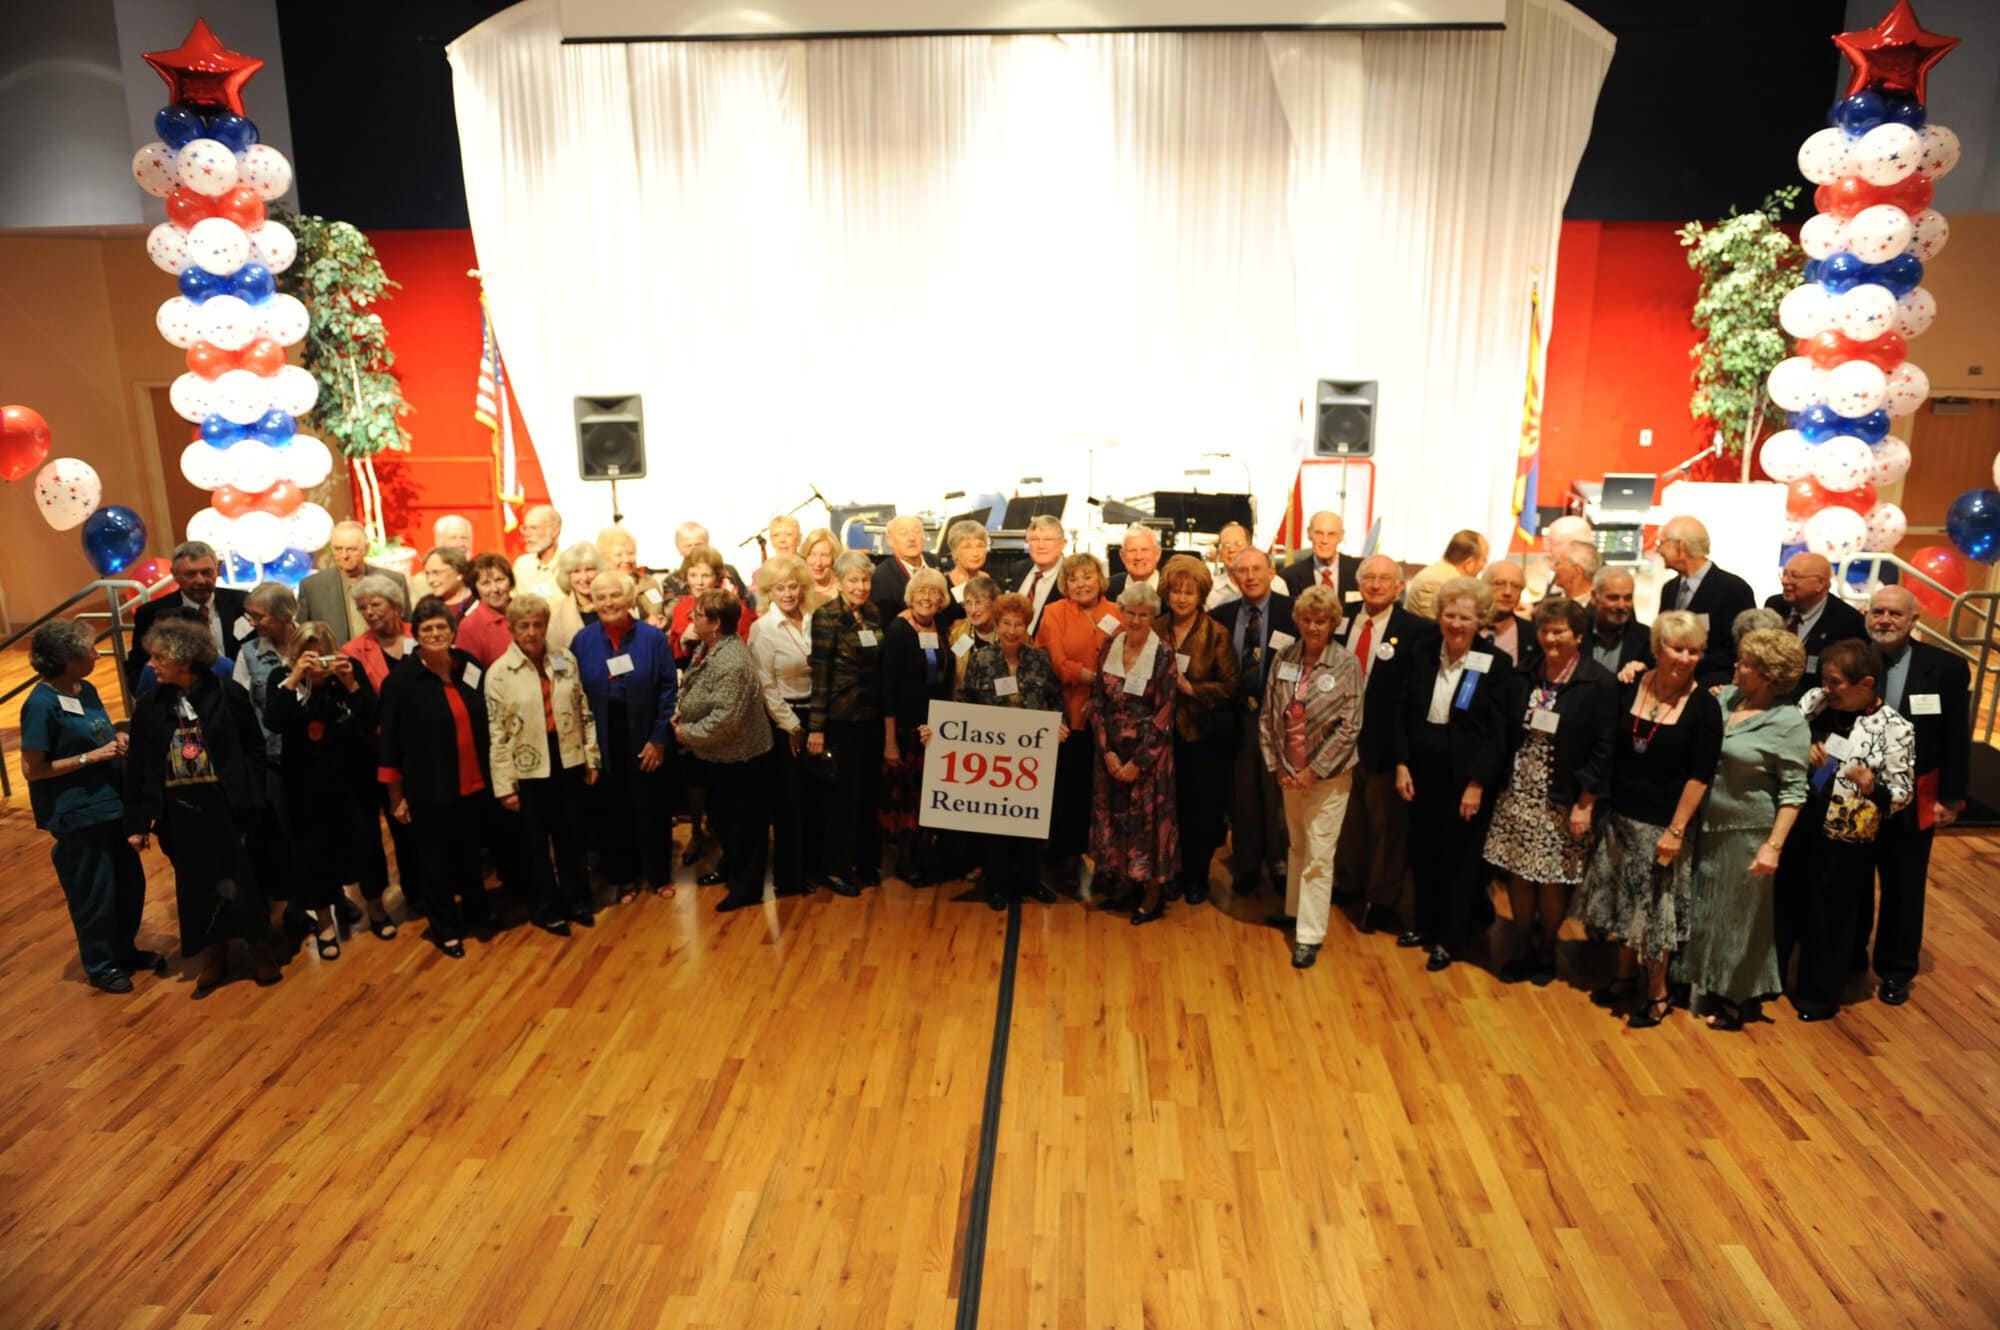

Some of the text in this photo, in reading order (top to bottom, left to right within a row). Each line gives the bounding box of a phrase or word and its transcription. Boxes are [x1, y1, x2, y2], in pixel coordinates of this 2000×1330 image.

[939, 720, 1049, 749] Class of
[940, 751, 1039, 791] 1958
[930, 790, 1040, 820] Reunion
